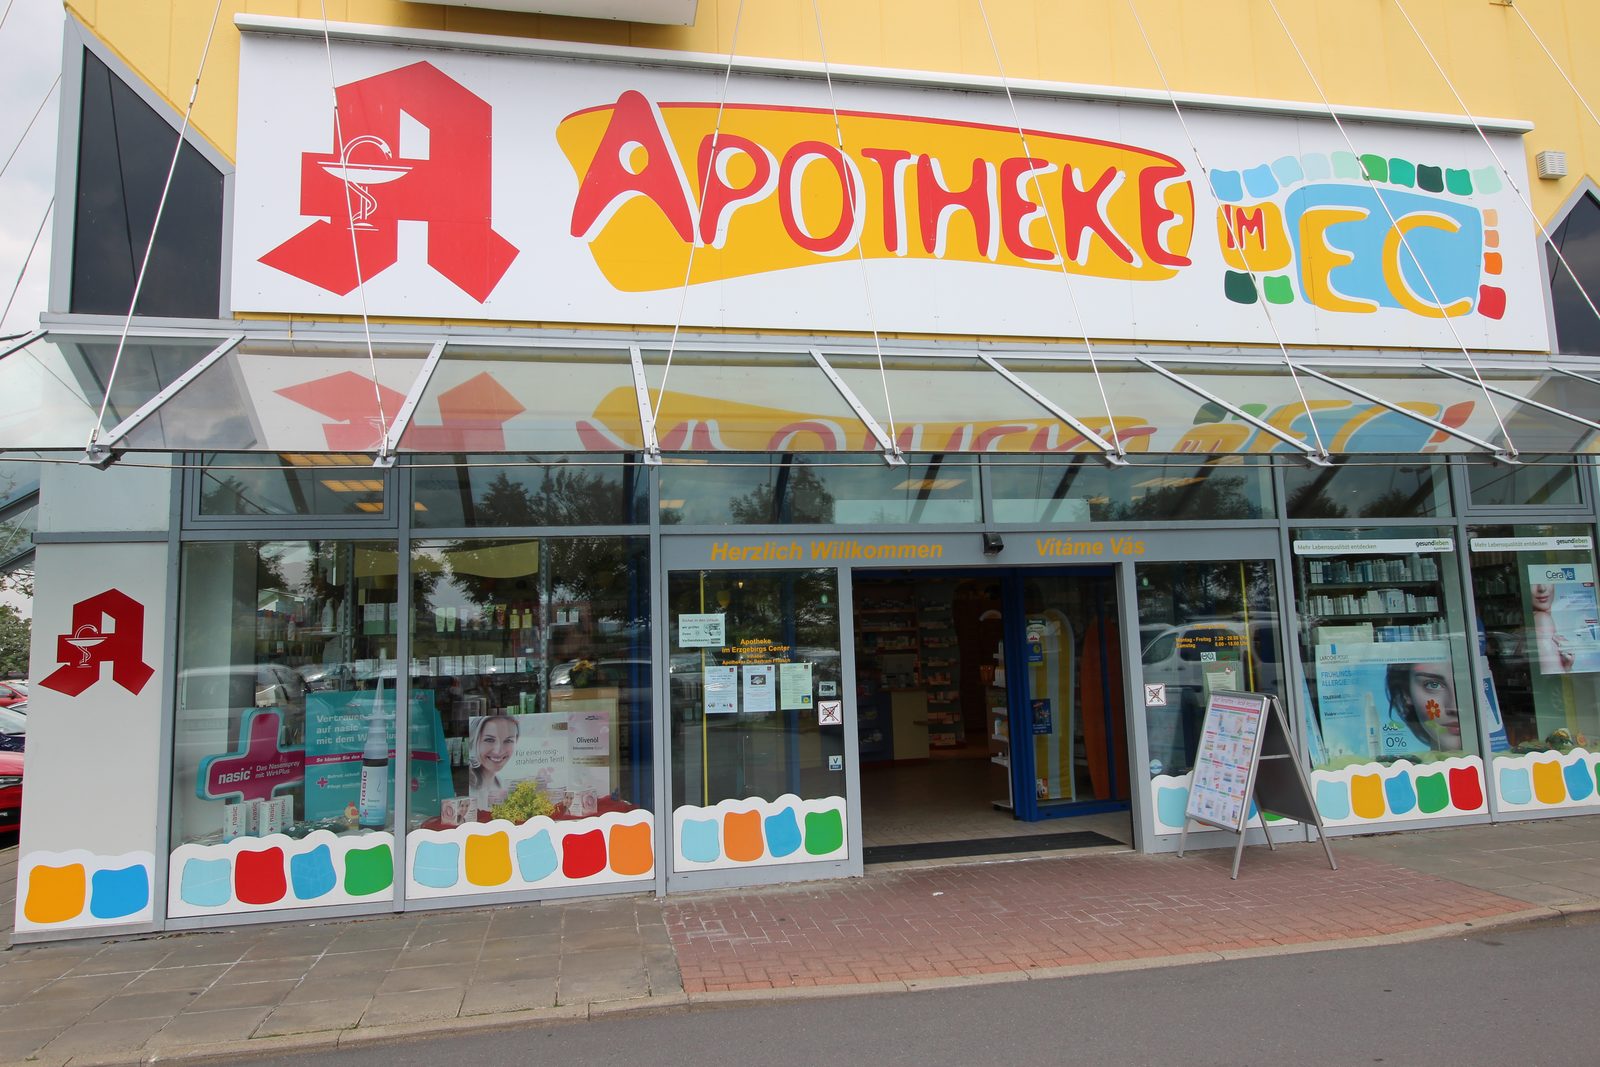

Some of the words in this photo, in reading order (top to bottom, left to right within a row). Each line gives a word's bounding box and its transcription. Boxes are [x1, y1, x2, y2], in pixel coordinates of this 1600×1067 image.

[570, 90, 1193, 269] APOTHEKE
[1224, 204, 1267, 251] IM
[1300, 206, 1474, 318] EC
[1109, 534, 1146, 555] Vás
[1415, 539, 1450, 548] gesundleben
[1556, 538, 1588, 546] gesundleben
[710, 541, 801, 562] Herzlich
[809, 540, 944, 560] Willkommen
[1546, 569, 1574, 580] CeraVe
[740, 638, 772, 646] Apotheke
[732, 646, 768, 654] Erzgebirgs
[316, 725, 332, 734] auf
[316, 736, 332, 745] mit
[335, 735, 354, 744] dem
[1386, 736, 1407, 748] 0%
[268, 761, 300, 770] Nasenspray
[515, 757, 549, 766] strahlenden
[218, 768, 250, 784] nasic
